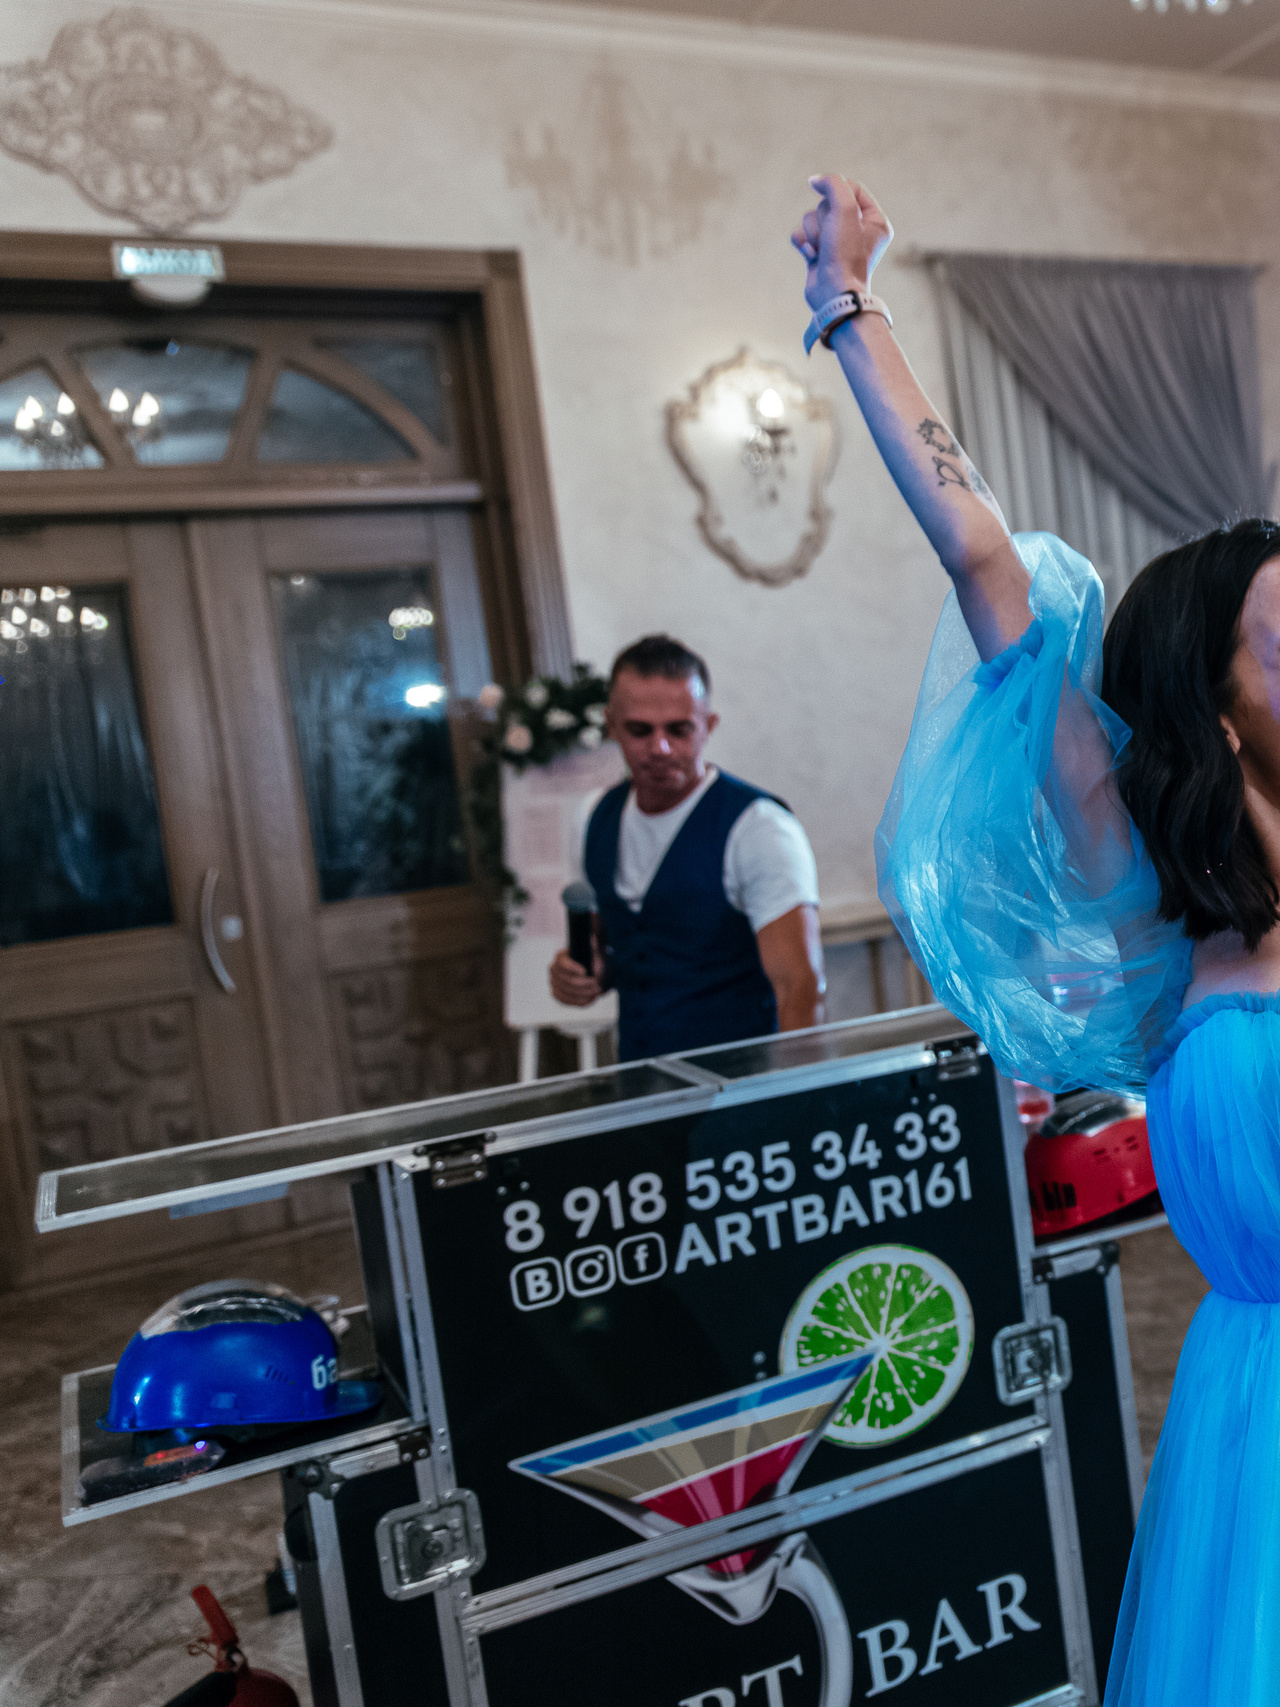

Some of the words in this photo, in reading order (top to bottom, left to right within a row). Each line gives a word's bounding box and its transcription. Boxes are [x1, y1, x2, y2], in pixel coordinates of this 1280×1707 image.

[503, 1199, 545, 1253] 8
[563, 1173, 667, 1239] 918
[686, 1141, 796, 1210] 535
[811, 1123, 882, 1180] 34
[894, 1104, 961, 1160] 33
[674, 1157, 972, 1274] ARTBAR161
[857, 1573, 1041, 1698] BAR
